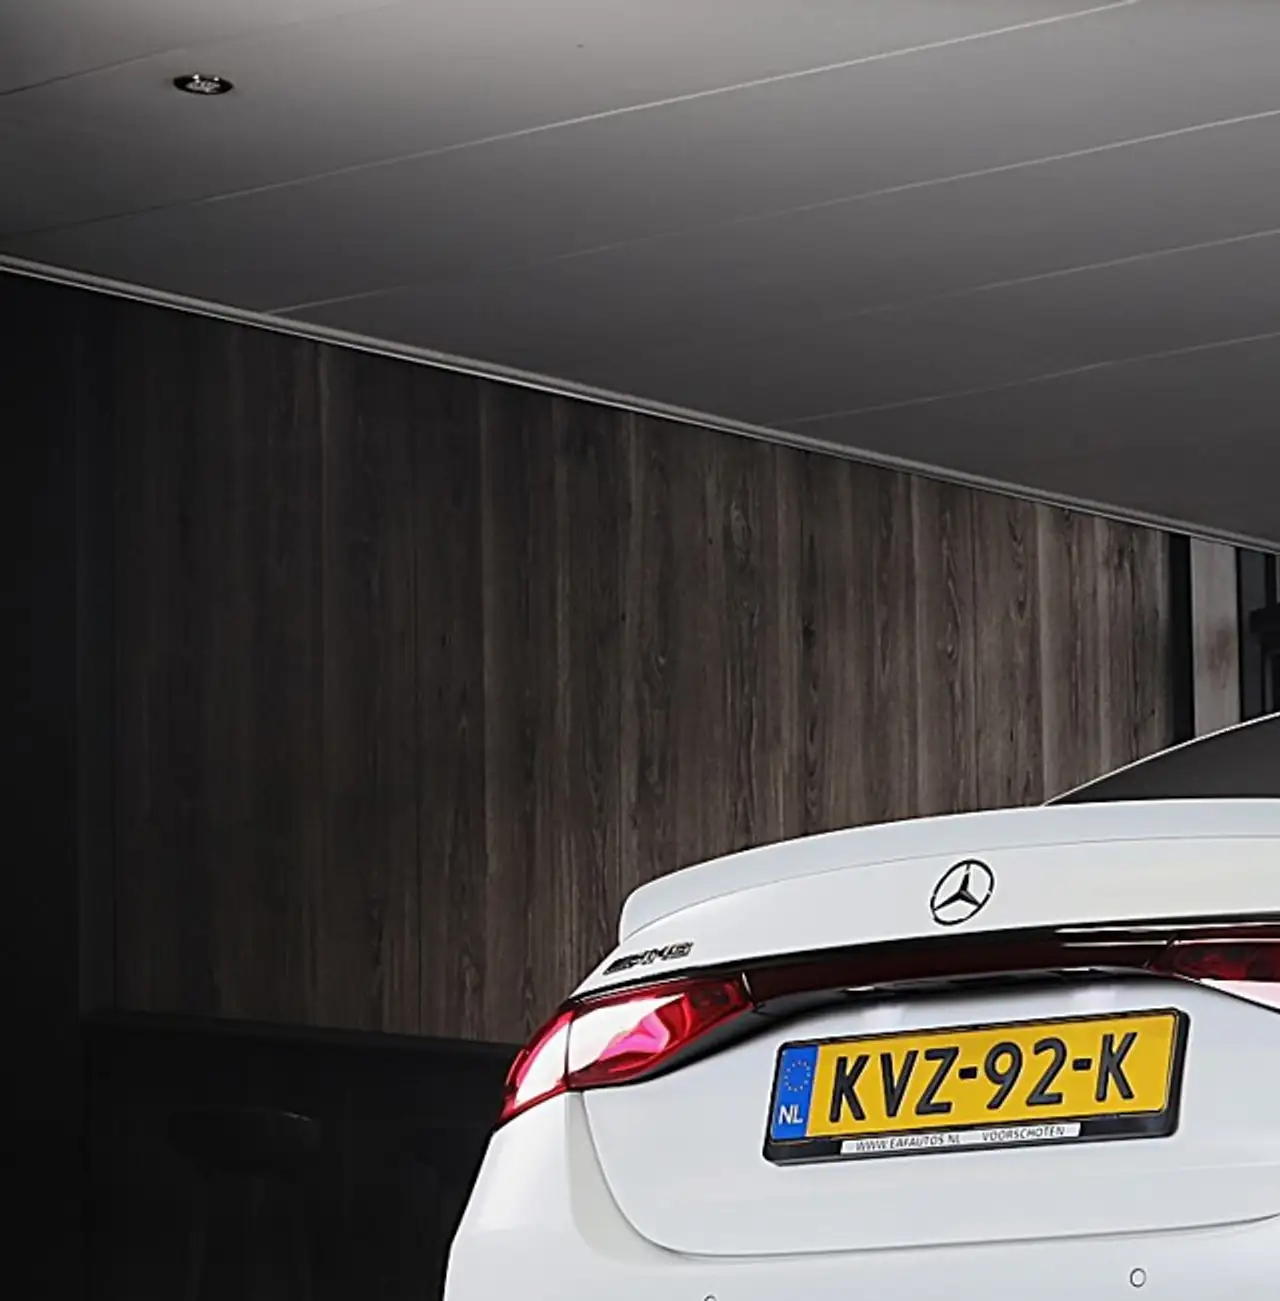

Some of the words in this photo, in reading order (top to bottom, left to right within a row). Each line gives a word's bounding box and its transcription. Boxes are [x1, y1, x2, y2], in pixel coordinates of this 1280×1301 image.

[829, 1031, 1138, 1123] KVZ-92-K
[778, 1105, 803, 1125] NL
[981, 1125, 1065, 1143] VOORSCHOTEN
